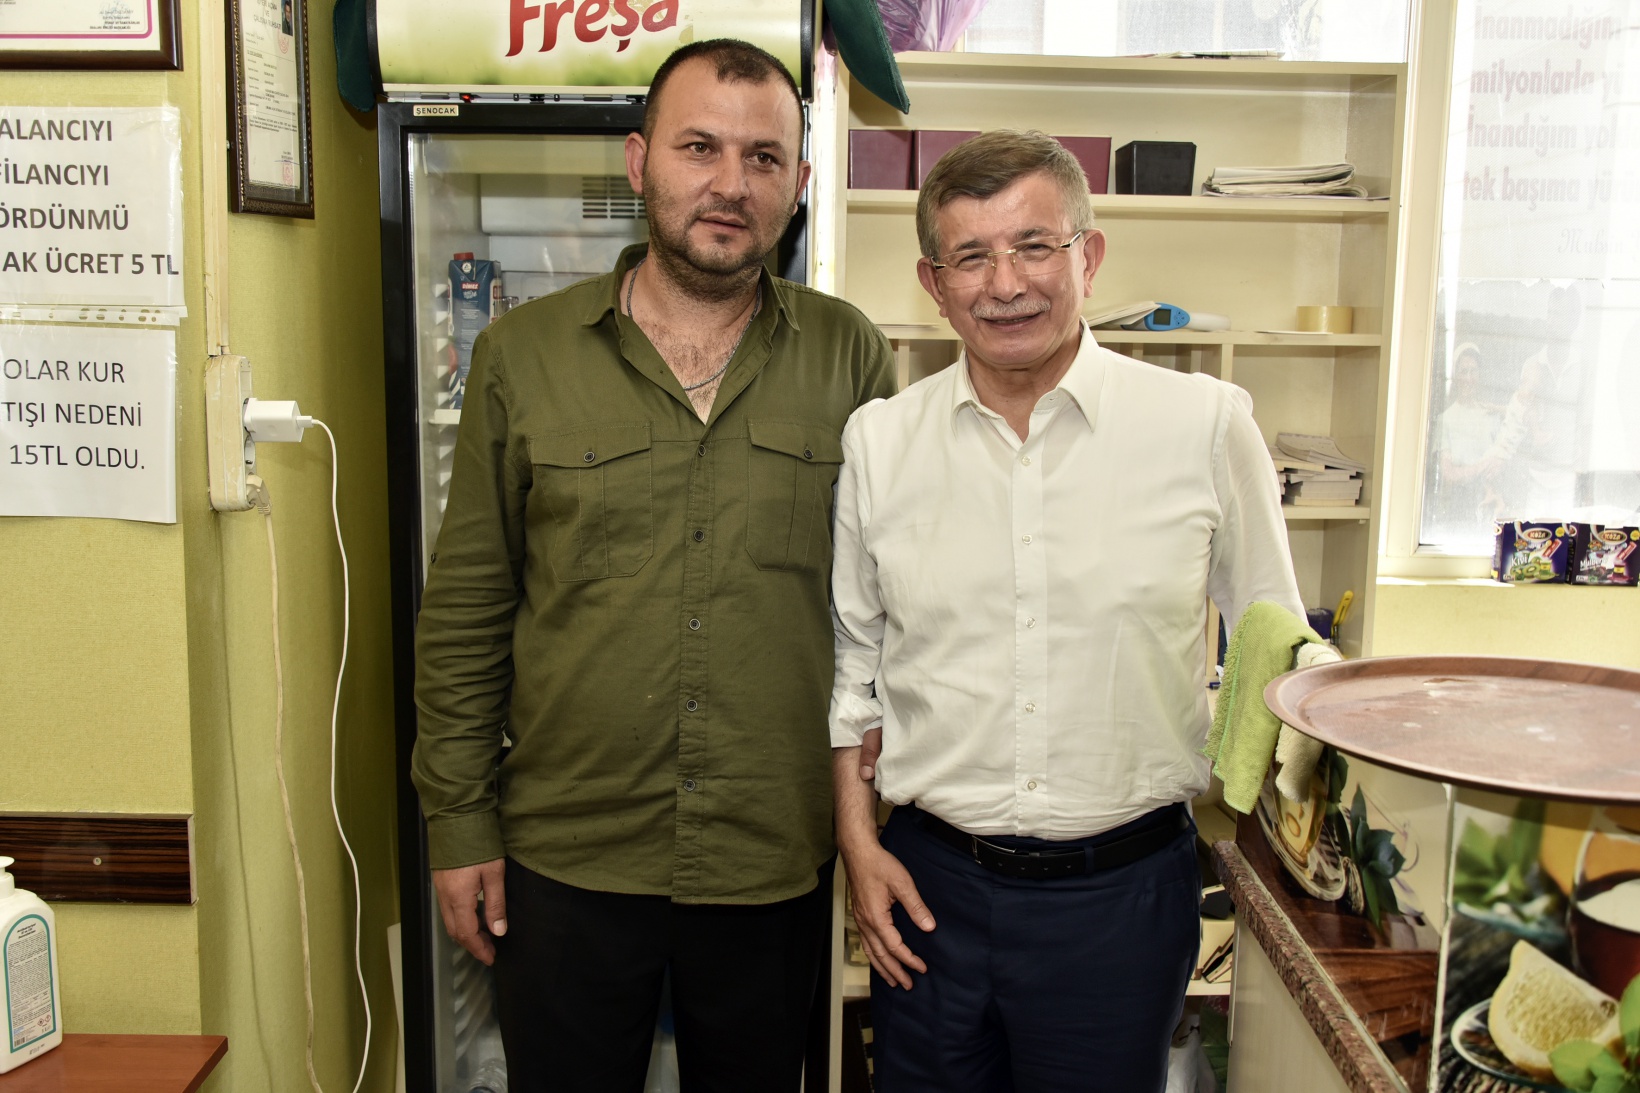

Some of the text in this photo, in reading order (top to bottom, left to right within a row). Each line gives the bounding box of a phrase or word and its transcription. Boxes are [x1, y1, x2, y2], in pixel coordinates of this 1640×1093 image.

[416, 107, 456, 115] ŞENOCAK
[2, 247, 180, 276] AK ÜCRET 5 TL
[3, 358, 125, 383] OLAR KUR
[1, 402, 142, 428] TIŞI NEDENİ
[9, 444, 146, 470] 15TL OLDU.
